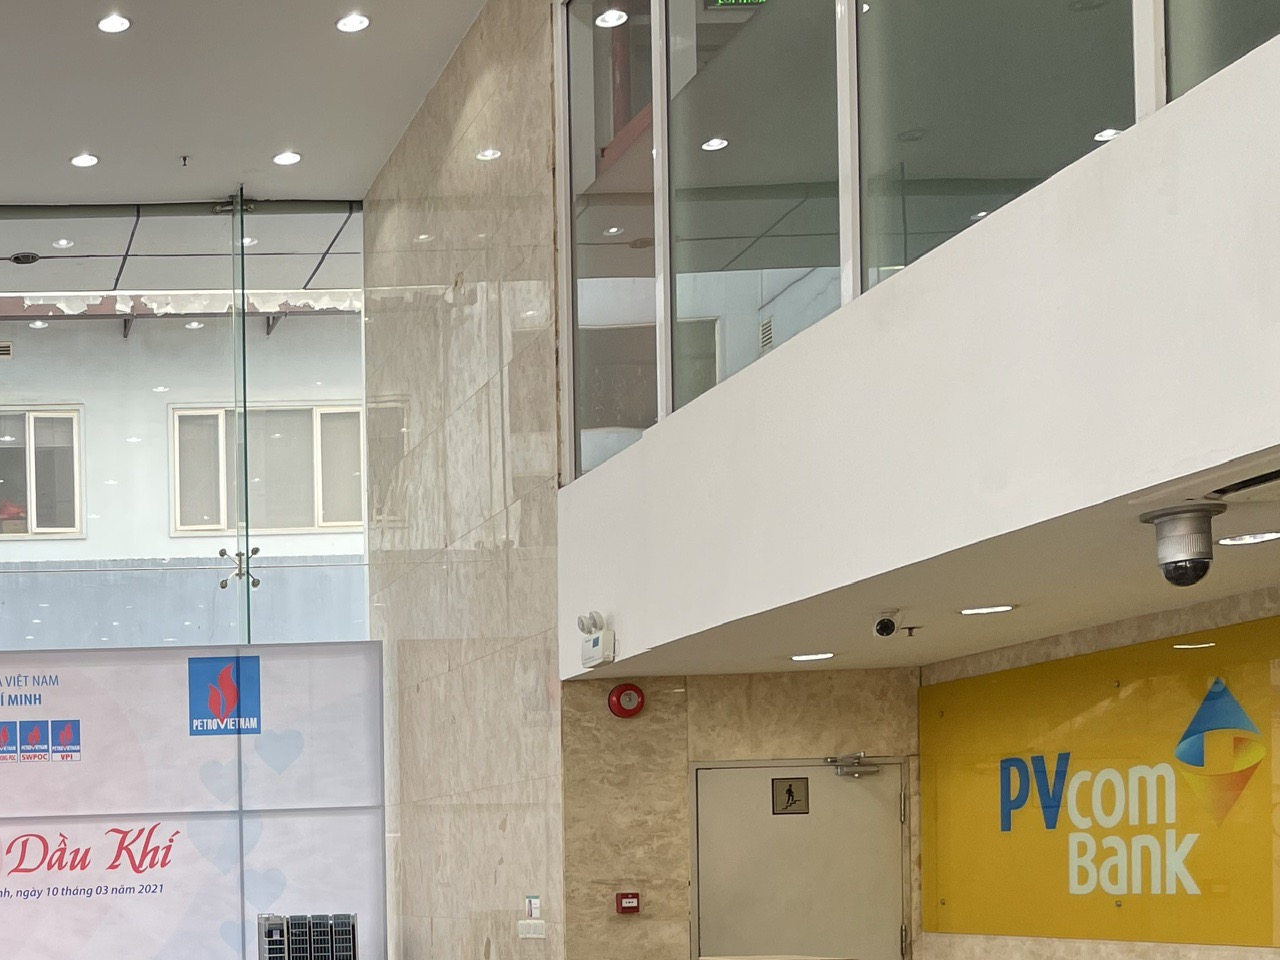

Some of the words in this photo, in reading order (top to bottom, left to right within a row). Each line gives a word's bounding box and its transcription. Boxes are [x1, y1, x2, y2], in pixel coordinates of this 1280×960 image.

[5, 673, 29, 689] VIỆT
[32, 674, 59, 687] NAM
[7, 693, 42, 707] MINH
[192, 717, 258, 730] PETROVIETNAM
[21, 753, 48, 761] SWPOC
[1000, 752, 1177, 832] PVcom
[5, 832, 92, 877] Dầu
[104, 822, 181, 874] Khí
[1068, 829, 1202, 895] Bank
[16, 887, 44, 900] ngày
[46, 886, 58, 897] 10
[61, 885, 93, 899] tháng
[95, 885, 109, 896] 03
[111, 885, 136, 895] năm
[138, 884, 164, 895] 2021
